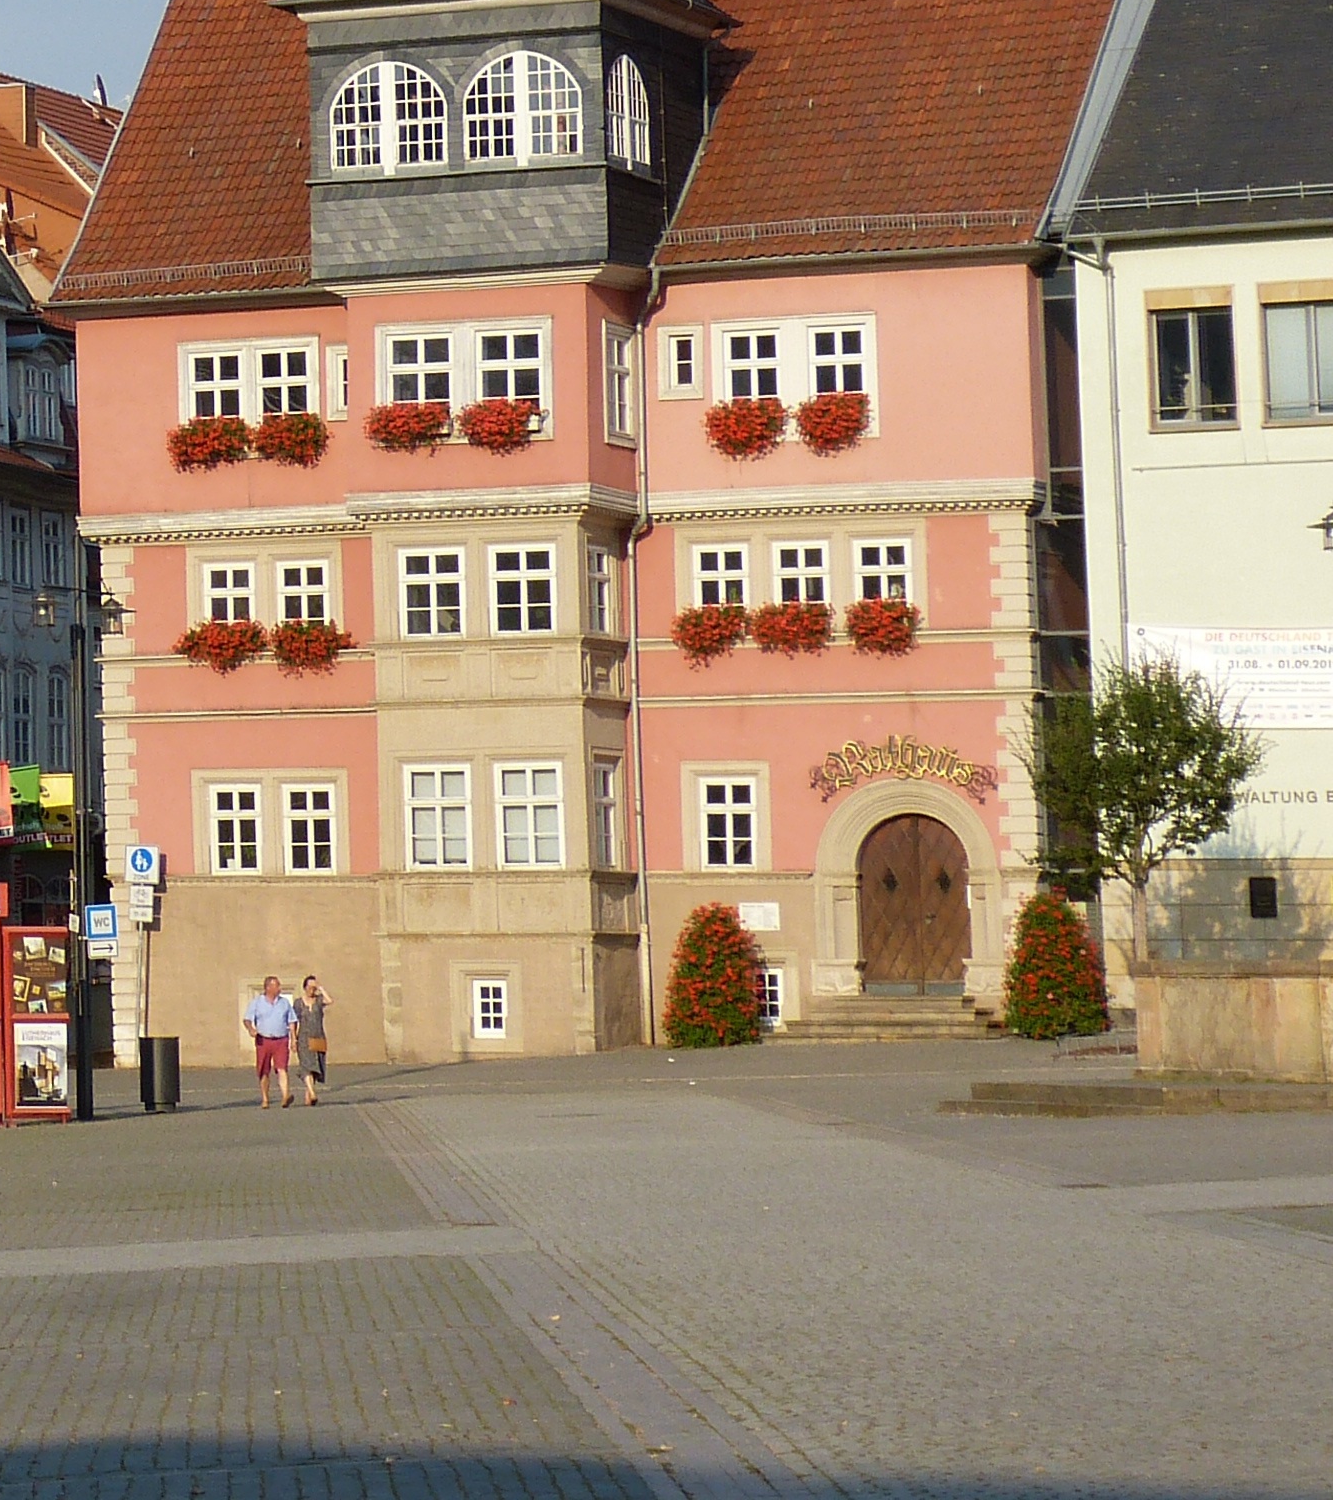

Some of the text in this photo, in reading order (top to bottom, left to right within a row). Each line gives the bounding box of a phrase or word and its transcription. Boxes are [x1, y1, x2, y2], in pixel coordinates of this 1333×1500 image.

[1205, 632, 1224, 642] DIE
[1229, 632, 1322, 642] DEUTSCHLAND
[822, 734, 974, 788] Rathaus
[93, 917, 110, 928] WC
